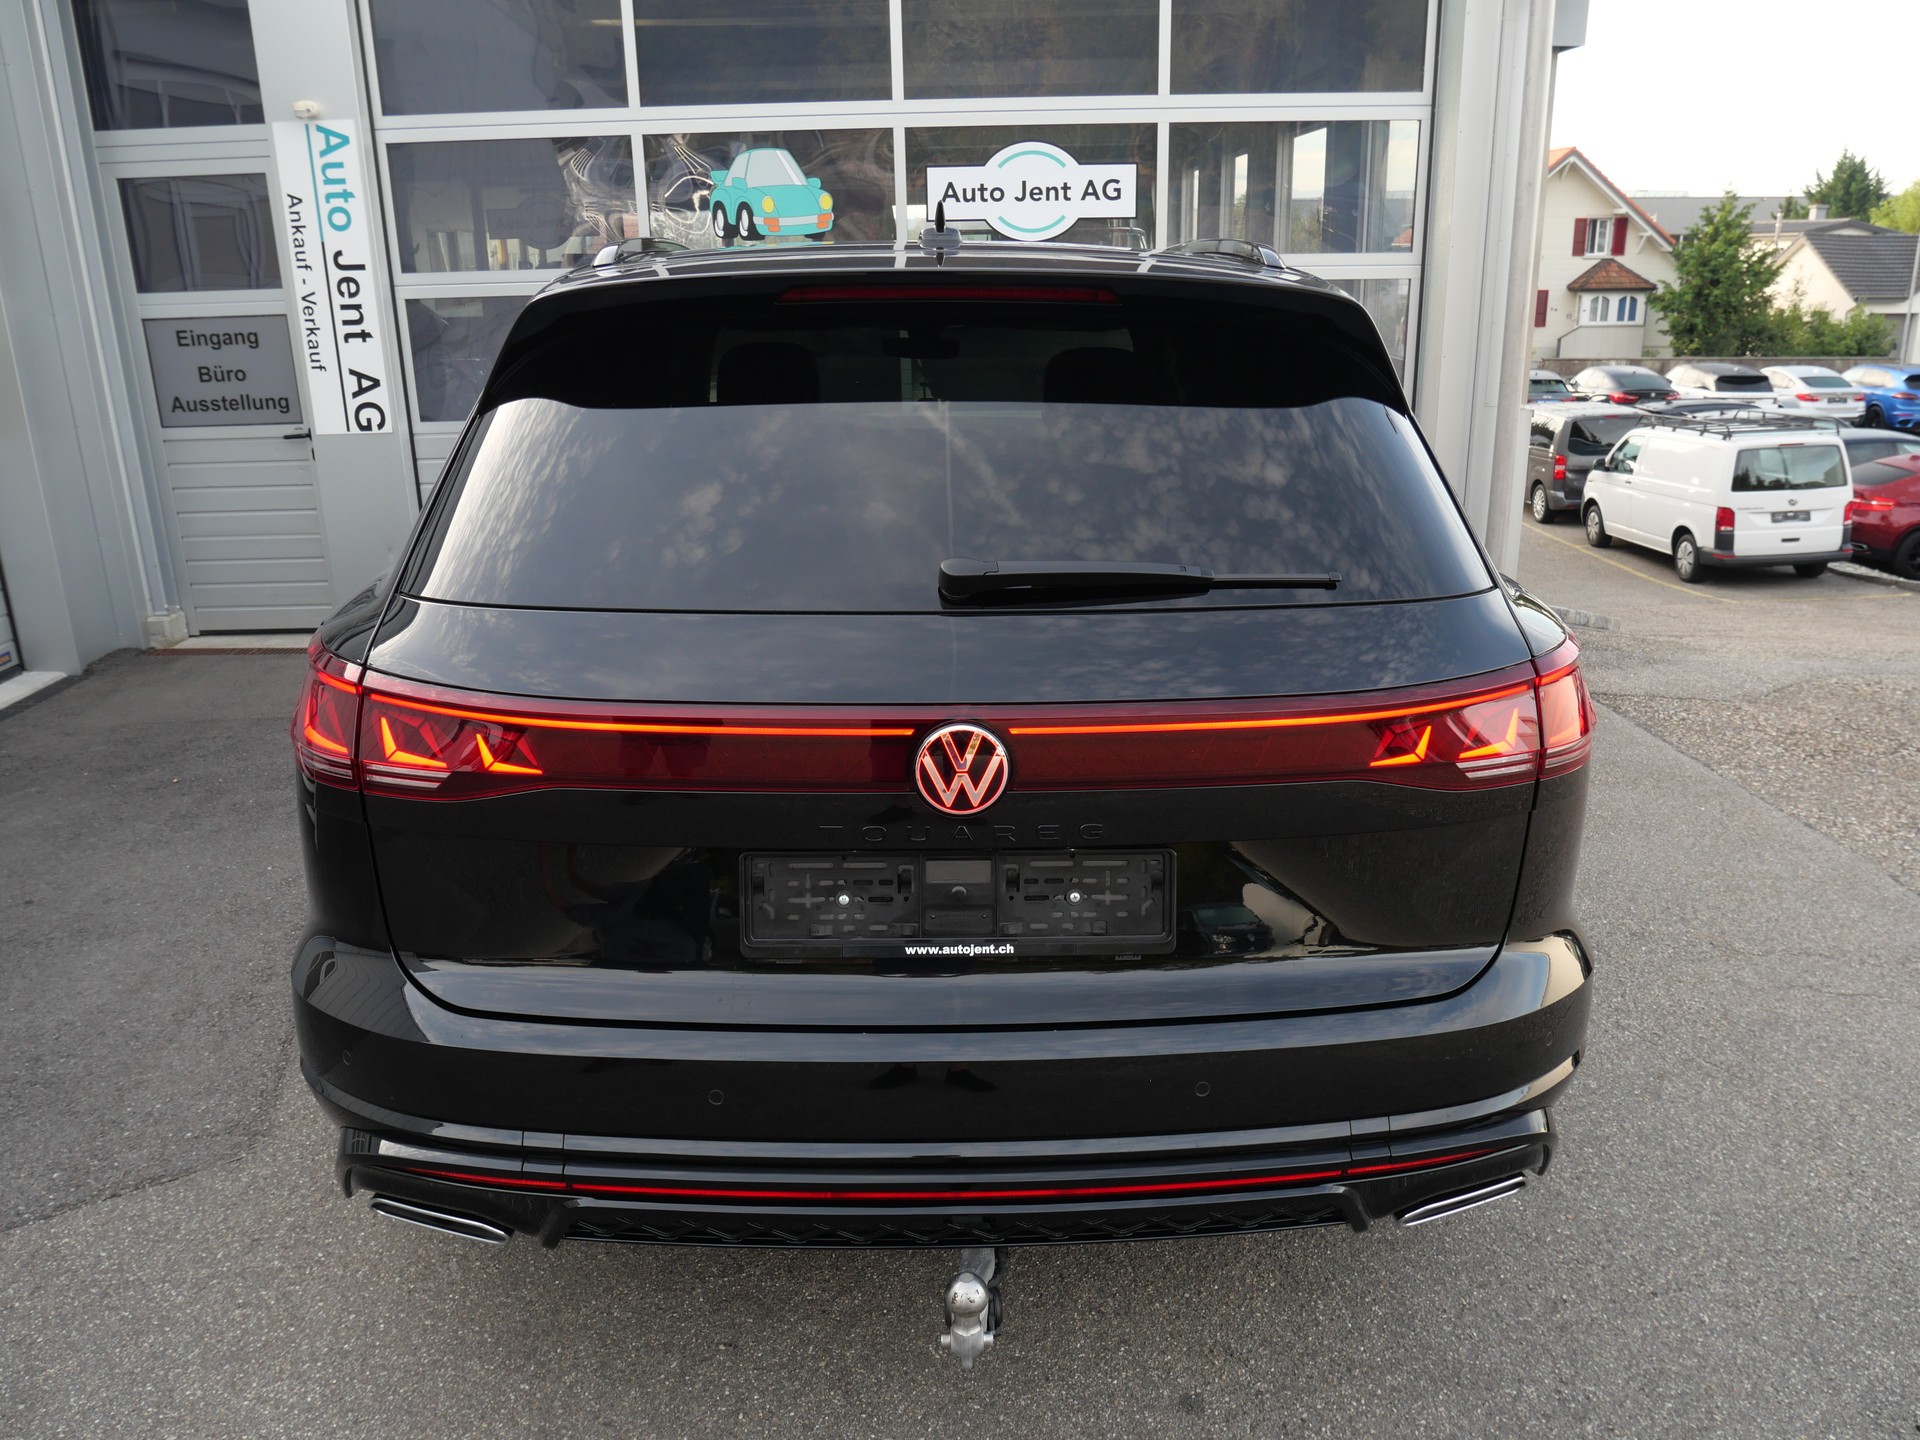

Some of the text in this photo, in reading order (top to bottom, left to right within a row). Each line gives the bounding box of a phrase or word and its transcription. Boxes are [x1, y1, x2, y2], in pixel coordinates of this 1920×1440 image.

[942, 178, 1122, 203] Auto Jent AG
[287, 193, 313, 271] Ankauf
[301, 291, 327, 372] Verkauf
[315, 125, 387, 433] Auto Jent AG
[175, 329, 260, 351] Eingang
[197, 365, 247, 383] Büro
[170, 393, 291, 415] Ausstellung
[818, 823, 1104, 842] TOUAREG
[904, 943, 1015, 957] www.autojent.ch
